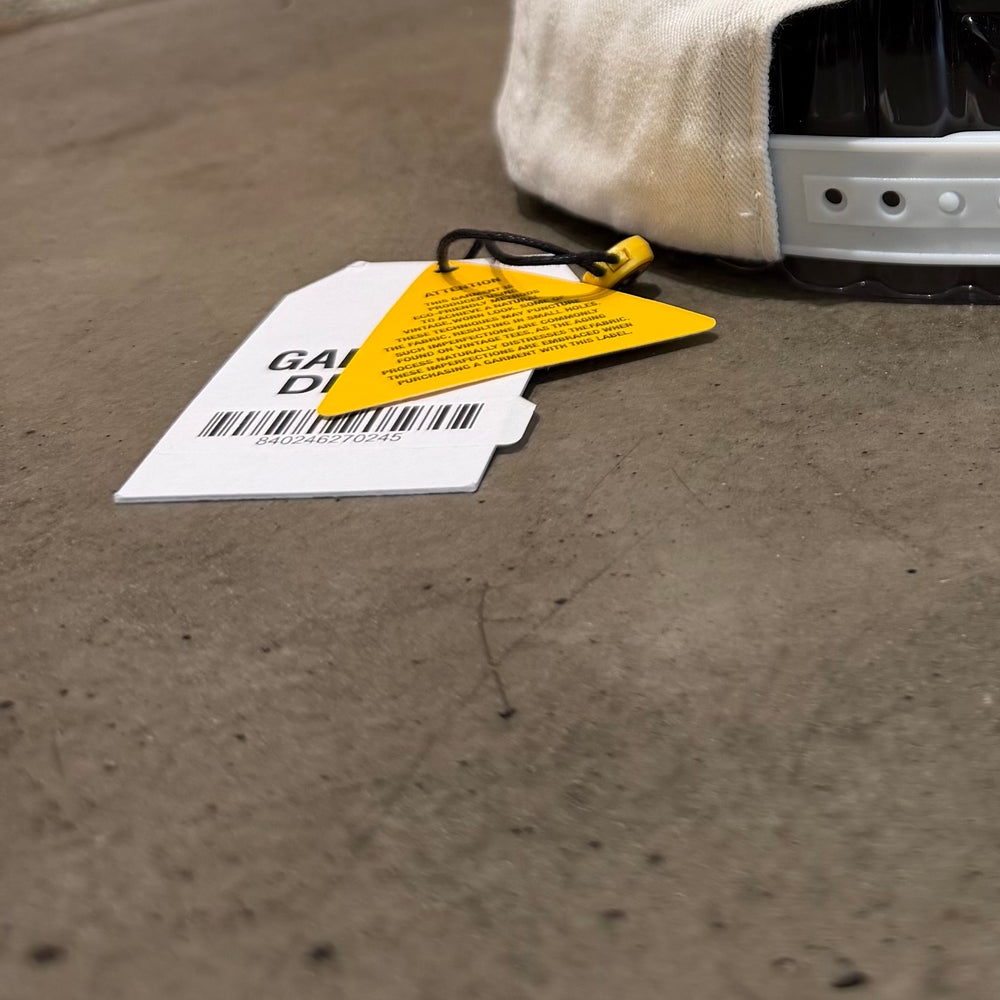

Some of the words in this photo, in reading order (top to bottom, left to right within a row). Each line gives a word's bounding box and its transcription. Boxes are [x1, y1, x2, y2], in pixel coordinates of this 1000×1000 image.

[413, 301, 487, 320] ECO-FRIENDLY
[490, 289, 540, 303] METHODS
[425, 277, 501, 298] ATTENTION
[428, 296, 484, 311] PRODUCED
[451, 287, 500, 300] GARMENT
[395, 332, 430, 343] THESE
[433, 316, 499, 334] TECHNIQUES
[501, 310, 524, 319] MAY
[527, 299, 581, 313] PUNCTURE
[438, 307, 481, 321] ACHIEVE
[453, 313, 484, 324] WORN
[520, 299, 547, 309] SOME
[384, 344, 406, 352] THE
[453, 321, 511, 336] RESULTING
[527, 310, 564, 321] SMALL
[396, 347, 425, 358] SUCH
[428, 327, 514, 349] IMPERFECTIONS
[517, 321, 537, 330] ARE
[540, 308, 598, 325] COMMONLY
[397, 351, 435, 364] FOUND
[438, 346, 454, 354] ON
[455, 336, 502, 350] VINTAGE
[535, 325, 550, 333] AS
[549, 320, 573, 329] THE
[574, 313, 607, 324] AGING
[381, 359, 434, 375] PROCESS
[435, 344, 498, 362] NATURALLY
[501, 330, 567, 347] DISTRESSES
[387, 369, 424, 381] THESE
[426, 348, 515, 371] IMPERFECTIONS
[518, 342, 540, 351] ARE
[542, 329, 600, 346] EMBRACED
[601, 322, 633, 332] WHEN
[398, 365, 471, 386] PURCHASING
[484, 350, 537, 365] GARMENT
[540, 344, 568, 353] WITH
[570, 338, 594, 347] THIS
[596, 330, 633, 341] LABEL.
[255, 433, 402, 446] 840246270245
